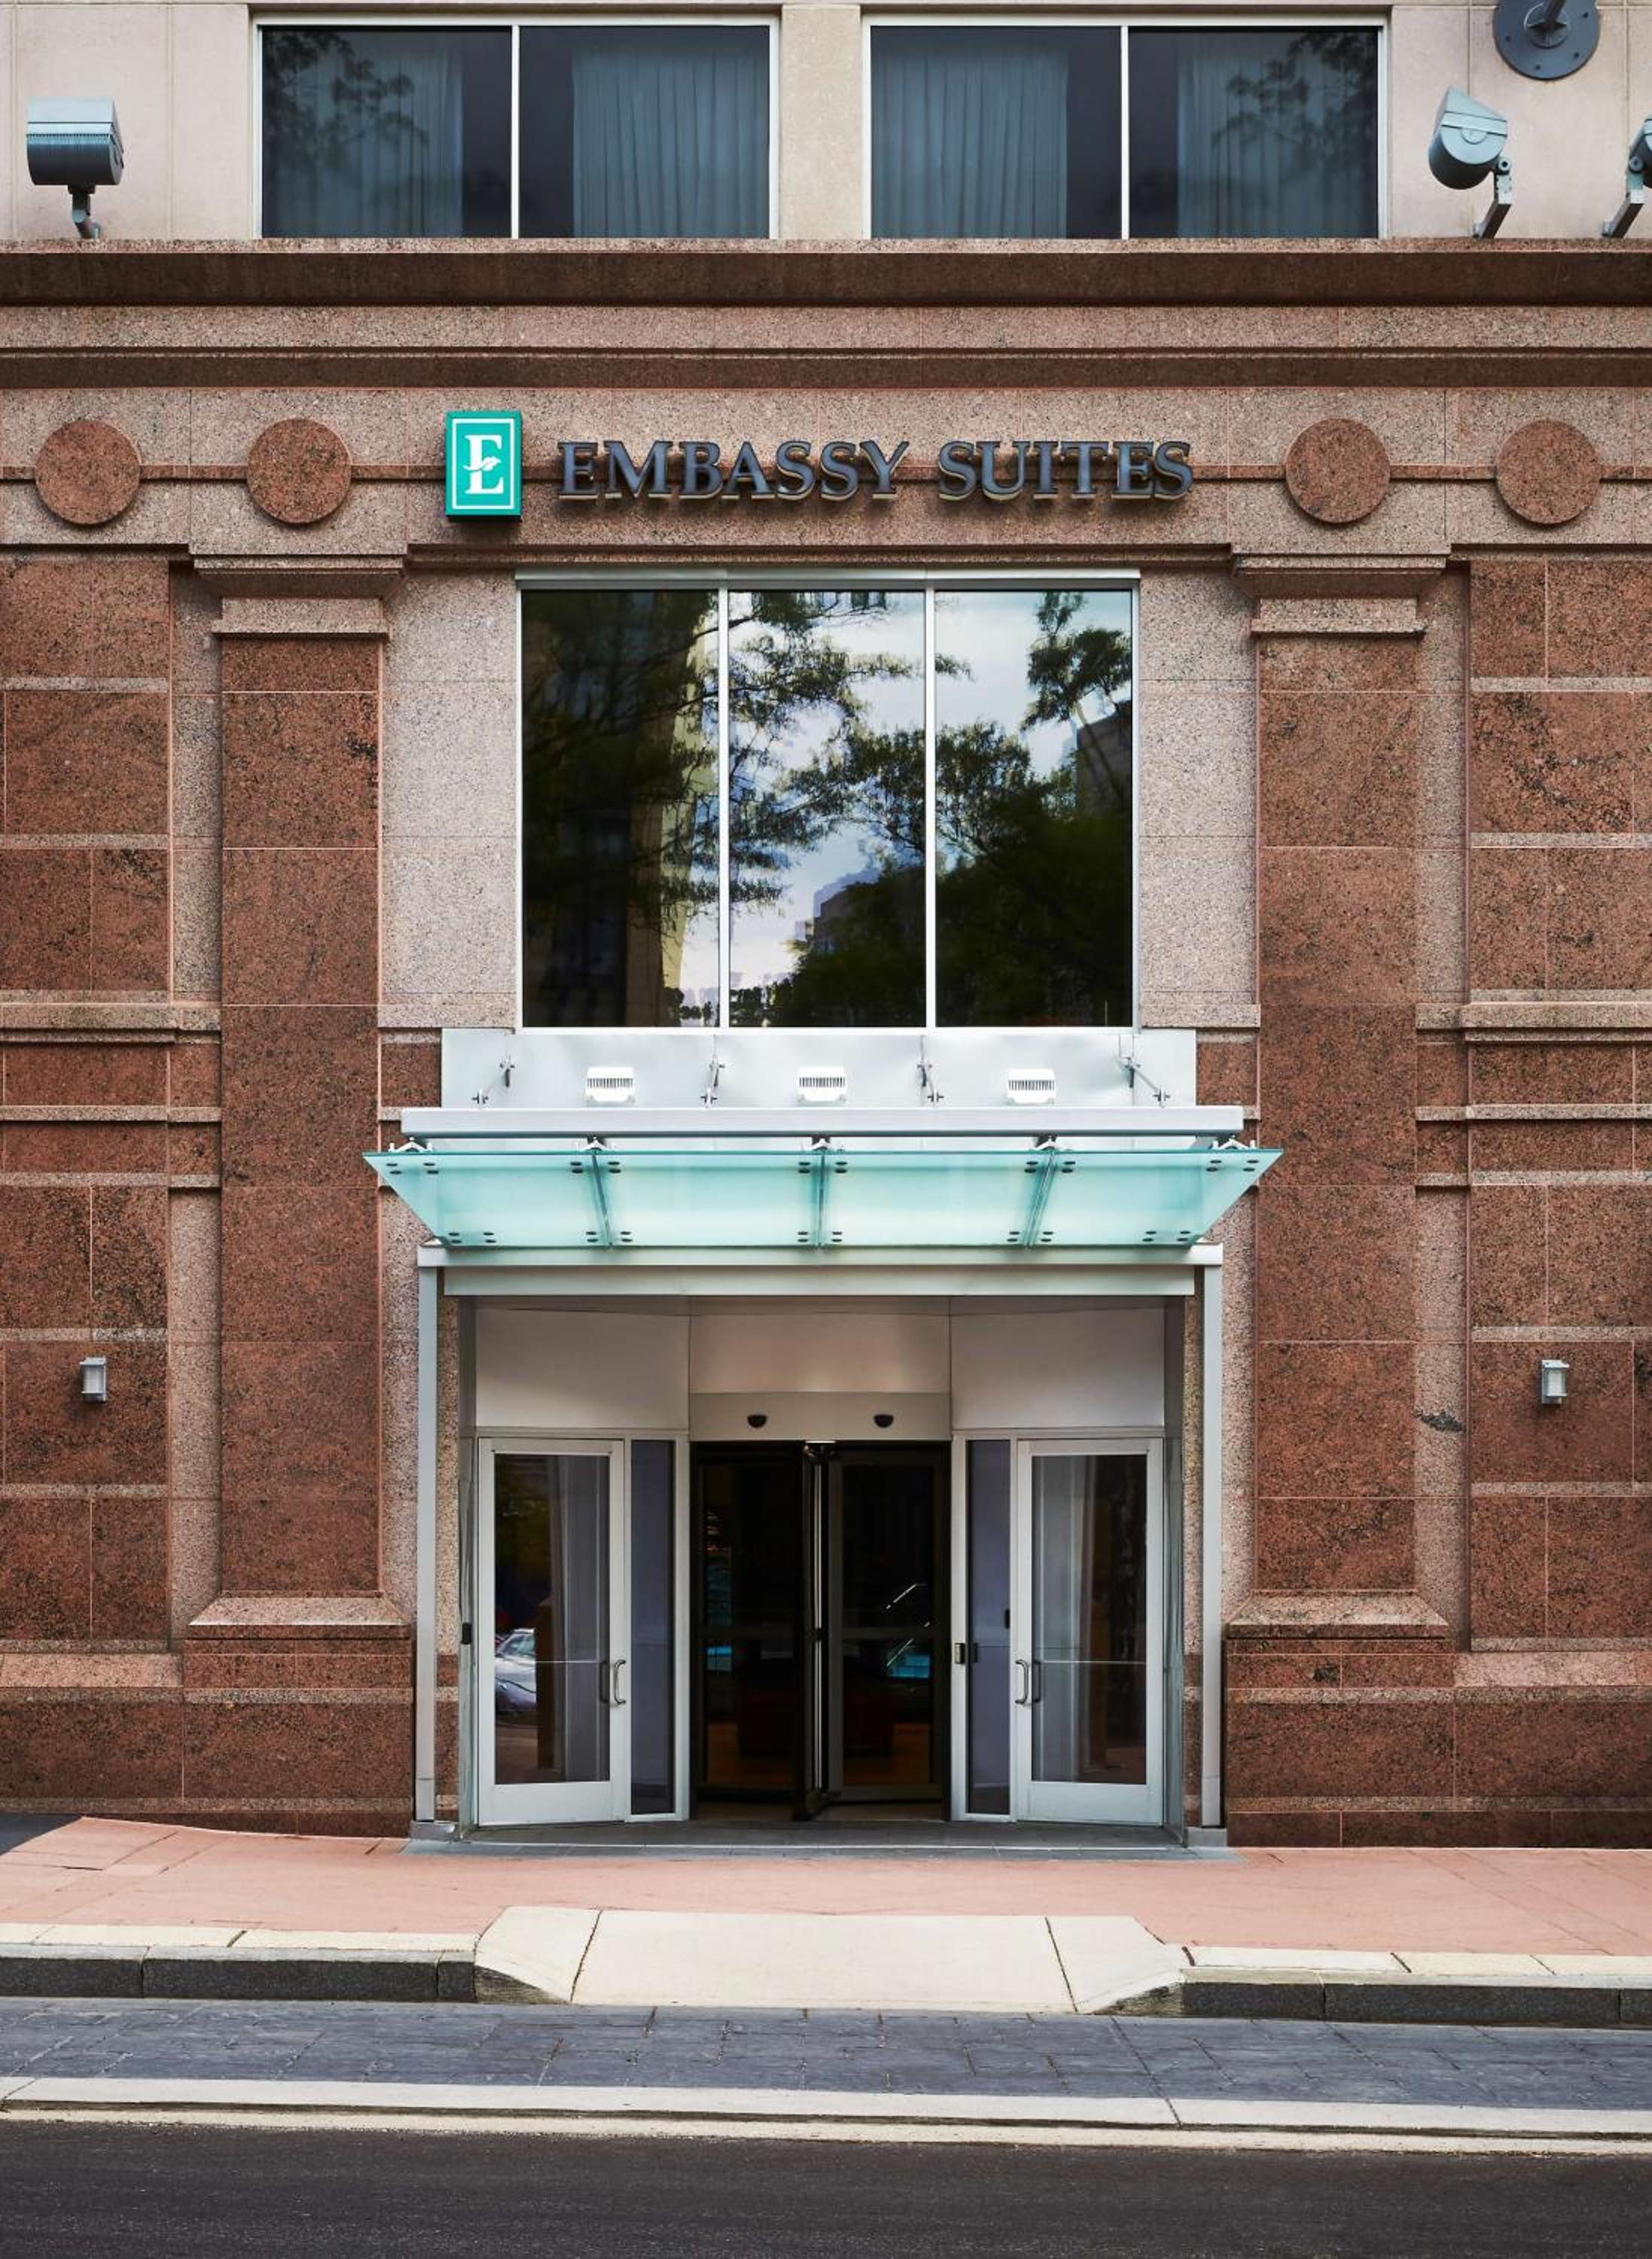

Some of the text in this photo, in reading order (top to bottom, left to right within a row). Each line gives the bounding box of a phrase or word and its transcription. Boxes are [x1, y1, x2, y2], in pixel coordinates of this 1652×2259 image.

[462, 434, 504, 495] E
[557, 440, 1194, 500] EMBASSY SUITES
